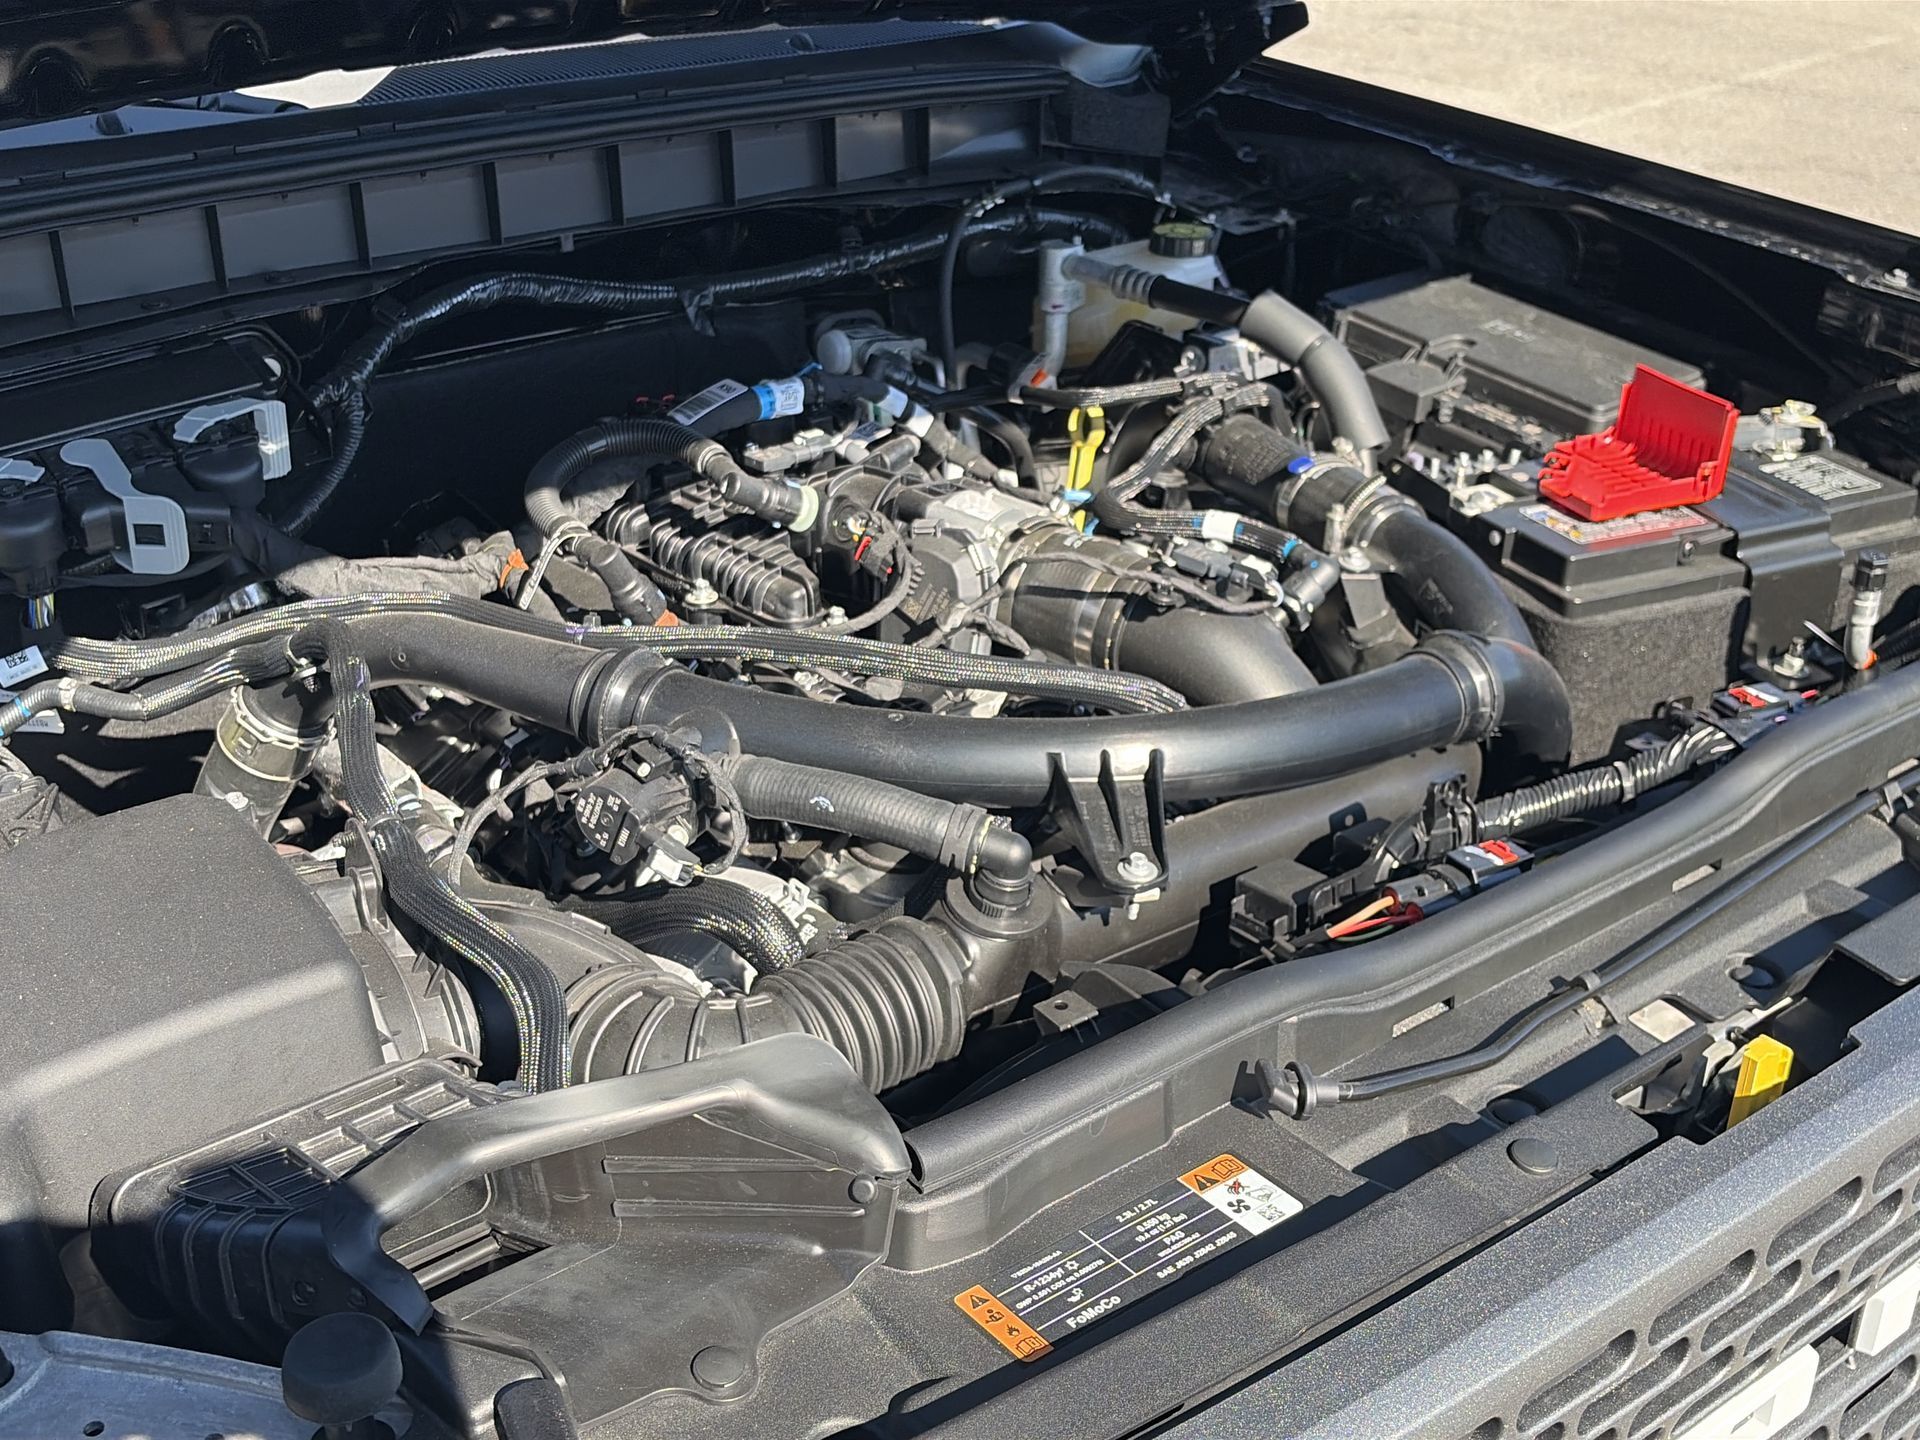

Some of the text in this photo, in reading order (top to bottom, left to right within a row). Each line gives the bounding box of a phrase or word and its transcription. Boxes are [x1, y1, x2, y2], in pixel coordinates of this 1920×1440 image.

[1116, 1208, 1136, 1223] 2.3L
[1138, 1199, 1158, 1211] 2.7L
[1136, 1212, 1171, 1232] 0.550 kg
[1163, 1230, 1185, 1245] PAG
[1156, 1265, 1176, 1279] SAE
[1066, 1296, 1121, 1329] FoMoCo
